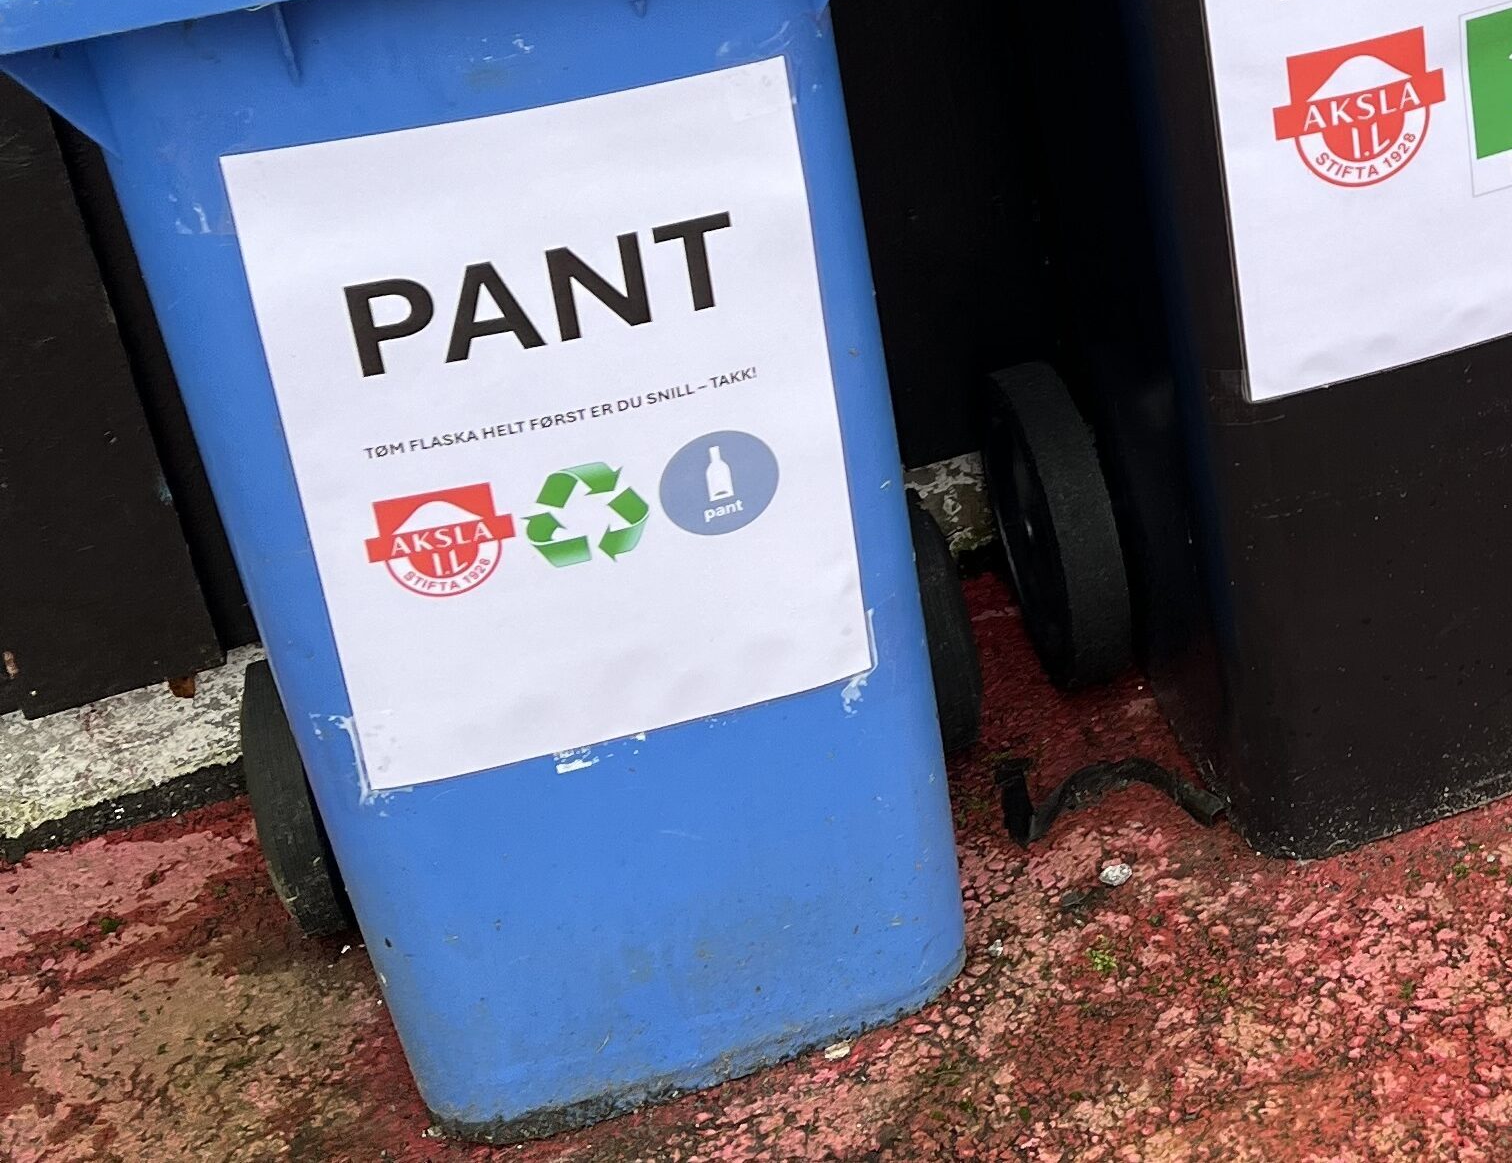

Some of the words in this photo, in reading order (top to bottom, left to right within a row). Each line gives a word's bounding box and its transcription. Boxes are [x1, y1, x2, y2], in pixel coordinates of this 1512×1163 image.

[1303, 81, 1421, 132] AKSLA
[1315, 152, 1380, 180] STIFTA
[1382, 132, 1417, 169] 1928
[343, 210, 732, 378] PANT
[363, 442, 405, 460] TØM
[409, 430, 479, 453] FLASKA
[482, 421, 527, 441] HELT
[529, 409, 587, 432] FØRST
[590, 402, 614, 418] ER
[617, 395, 643, 413] DU
[646, 384, 696, 405] SNILL
[710, 367, 758, 389] TAKK!
[703, 498, 745, 523] pant
[391, 521, 494, 557] AKSLA
[402, 570, 461, 591] STIFTA
[462, 557, 491, 584] 1928
